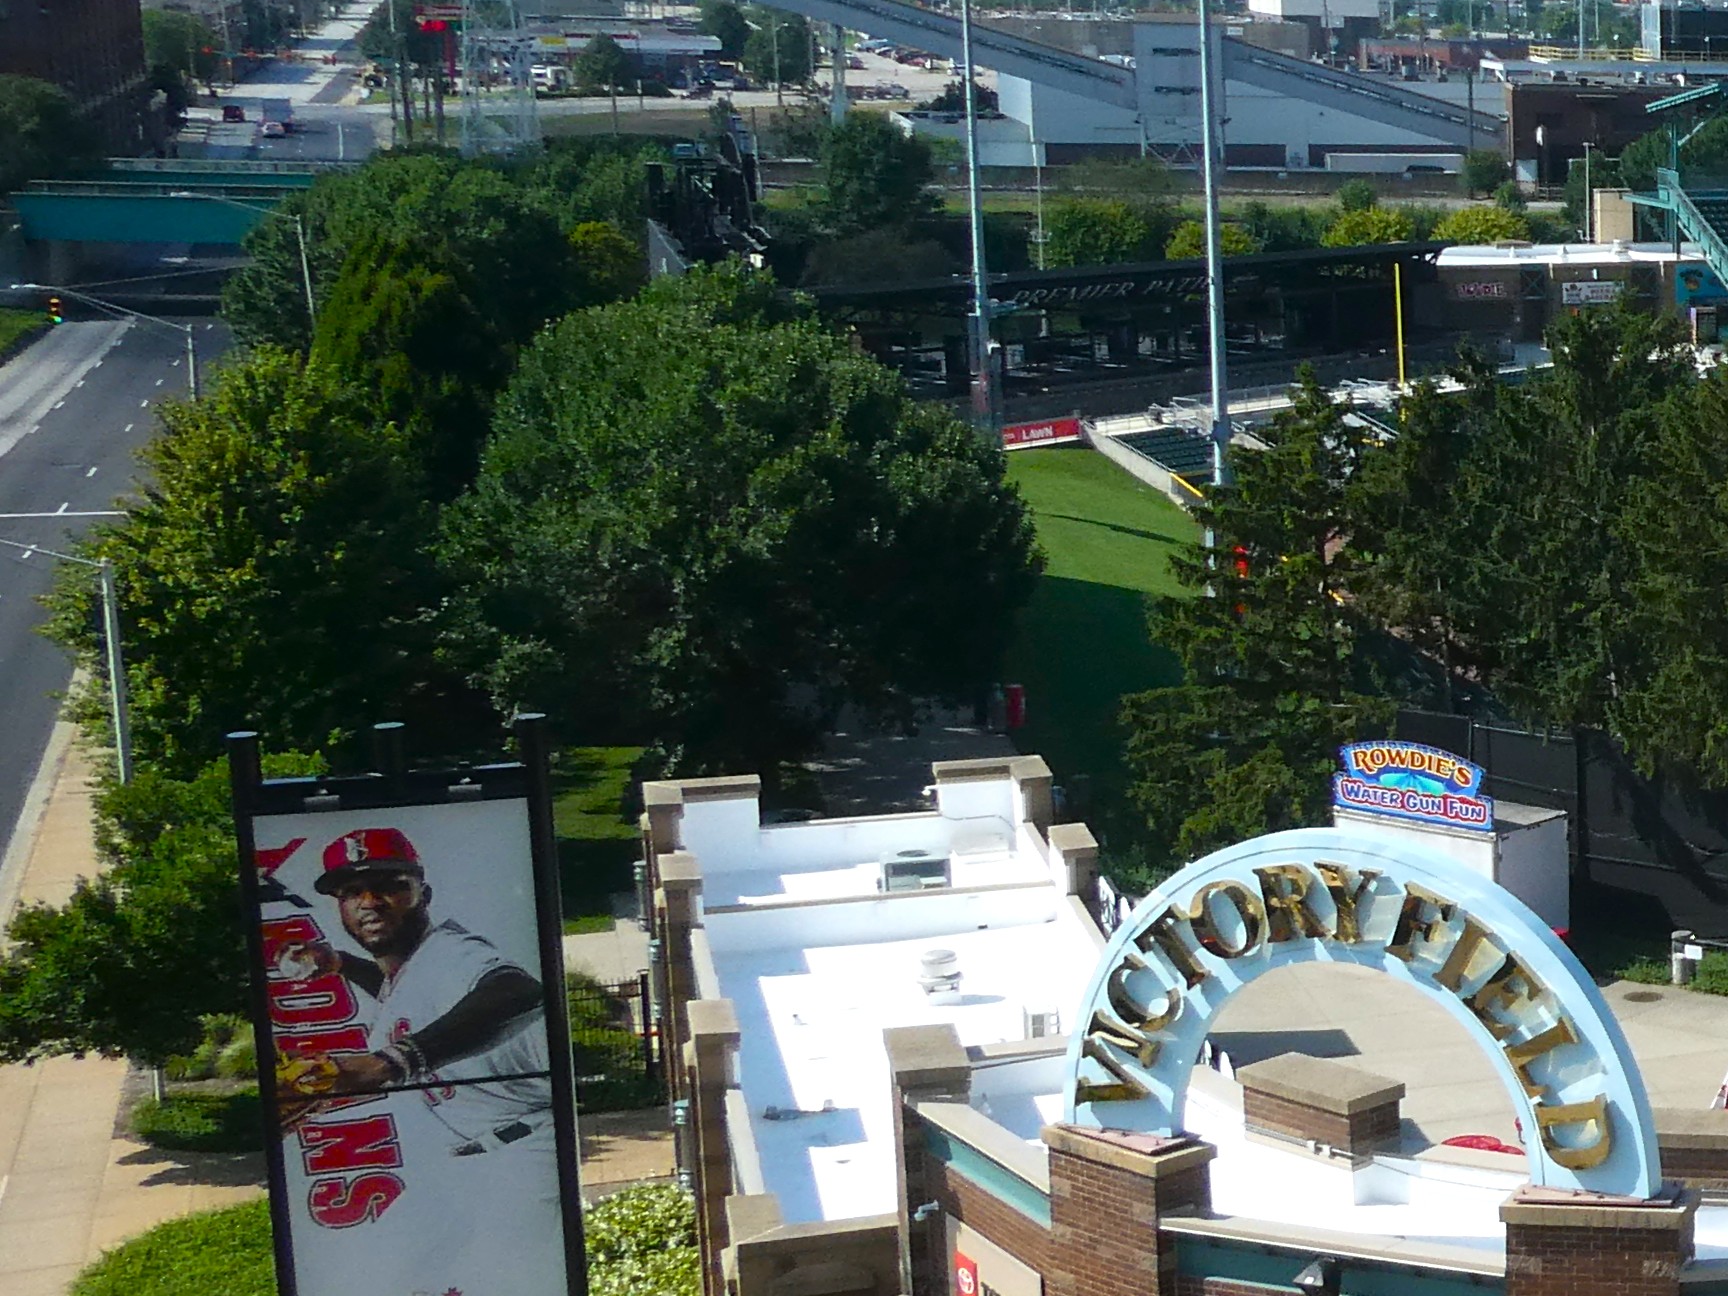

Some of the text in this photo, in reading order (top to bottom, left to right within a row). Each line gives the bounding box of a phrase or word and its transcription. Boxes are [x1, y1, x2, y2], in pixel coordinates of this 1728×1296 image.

[1142, 275, 1213, 295] PATI
[1021, 425, 1054, 441] LAWN
[1352, 746, 1472, 787] ROWDIE'S
[1343, 780, 1484, 820] WATER GUN FUN
[1073, 858, 1614, 1172] VICTORY FIELD
